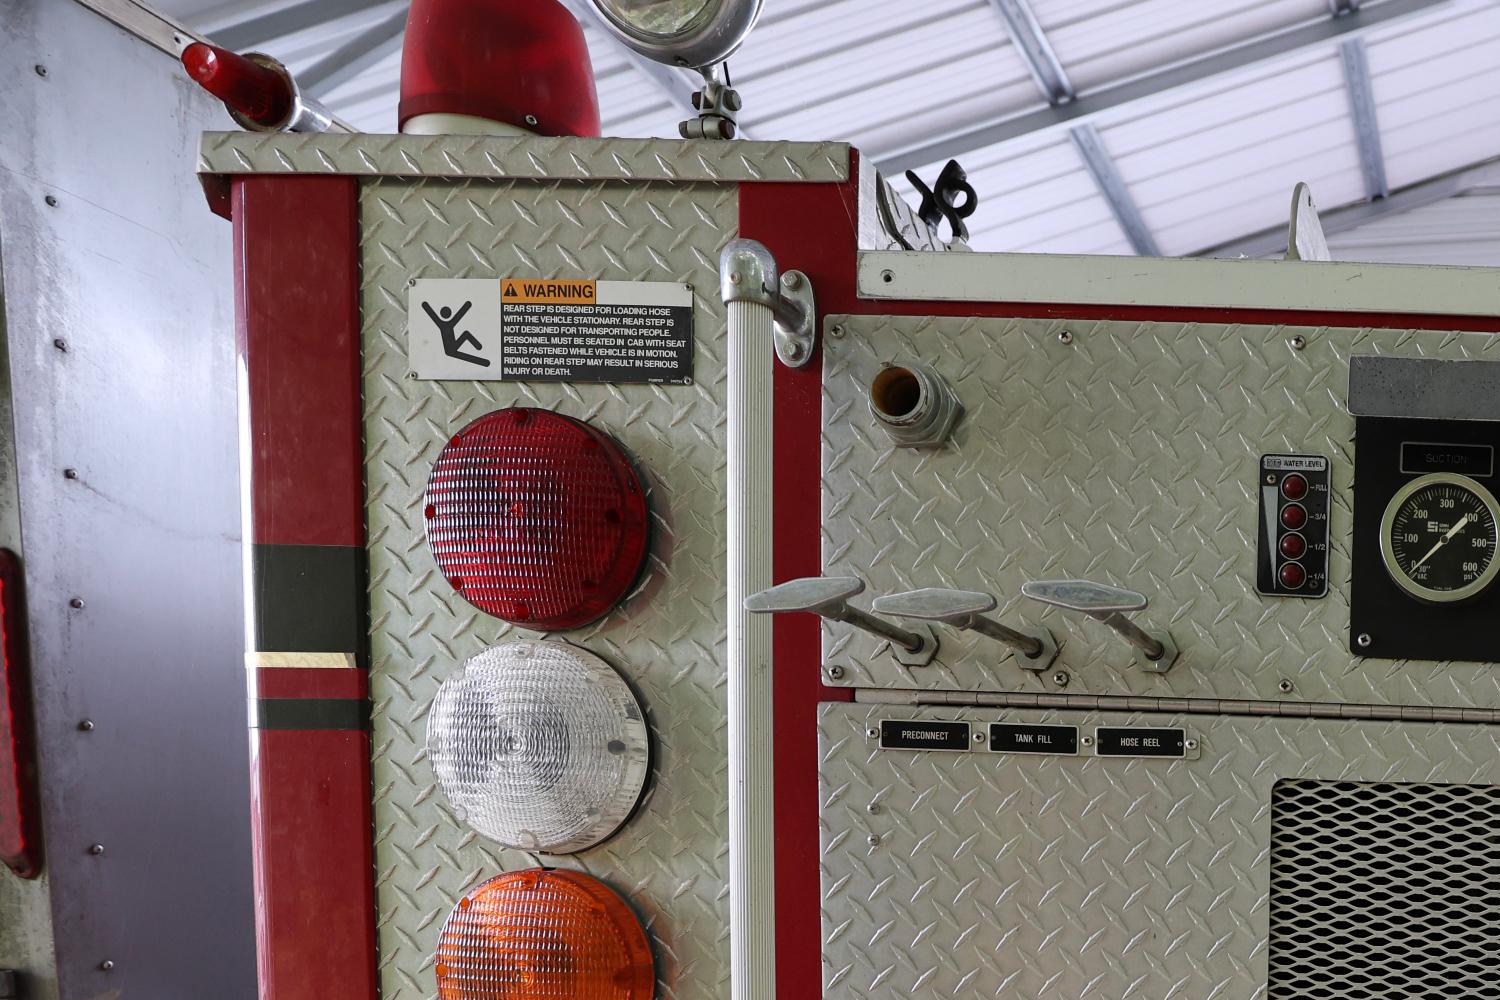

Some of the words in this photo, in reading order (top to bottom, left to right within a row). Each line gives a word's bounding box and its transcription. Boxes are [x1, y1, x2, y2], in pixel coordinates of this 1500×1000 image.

[524, 284, 593, 298] WARNING
[556, 306, 594, 314] DESIGNED
[596, 306, 611, 314] FOR
[613, 307, 647, 315] LOADING
[649, 308, 671, 316] HOSE
[574, 316, 621, 324] STATIONARY.
[521, 326, 559, 334] DESIGNED
[578, 327, 637, 336] TRANSPORTING
[504, 336, 550, 344] PERSONNEL
[1426, 453, 1467, 464] SUCTION
[1315, 484, 1328, 492] FULL
[1440, 500, 1454, 508] 300
[1413, 510, 1428, 519] 200
[1404, 534, 1418, 543] 100
[1472, 538, 1486, 547] 500
[1463, 562, 1477, 571] 600
[1464, 572, 1473, 581] psi
[902, 731, 948, 740] PRECONNECT
[1015, 734, 1033, 743] TANK
[1038, 735, 1052, 744] FILL
[1120, 738, 1139, 747] HOSE
[1143, 738, 1160, 747] REEL
